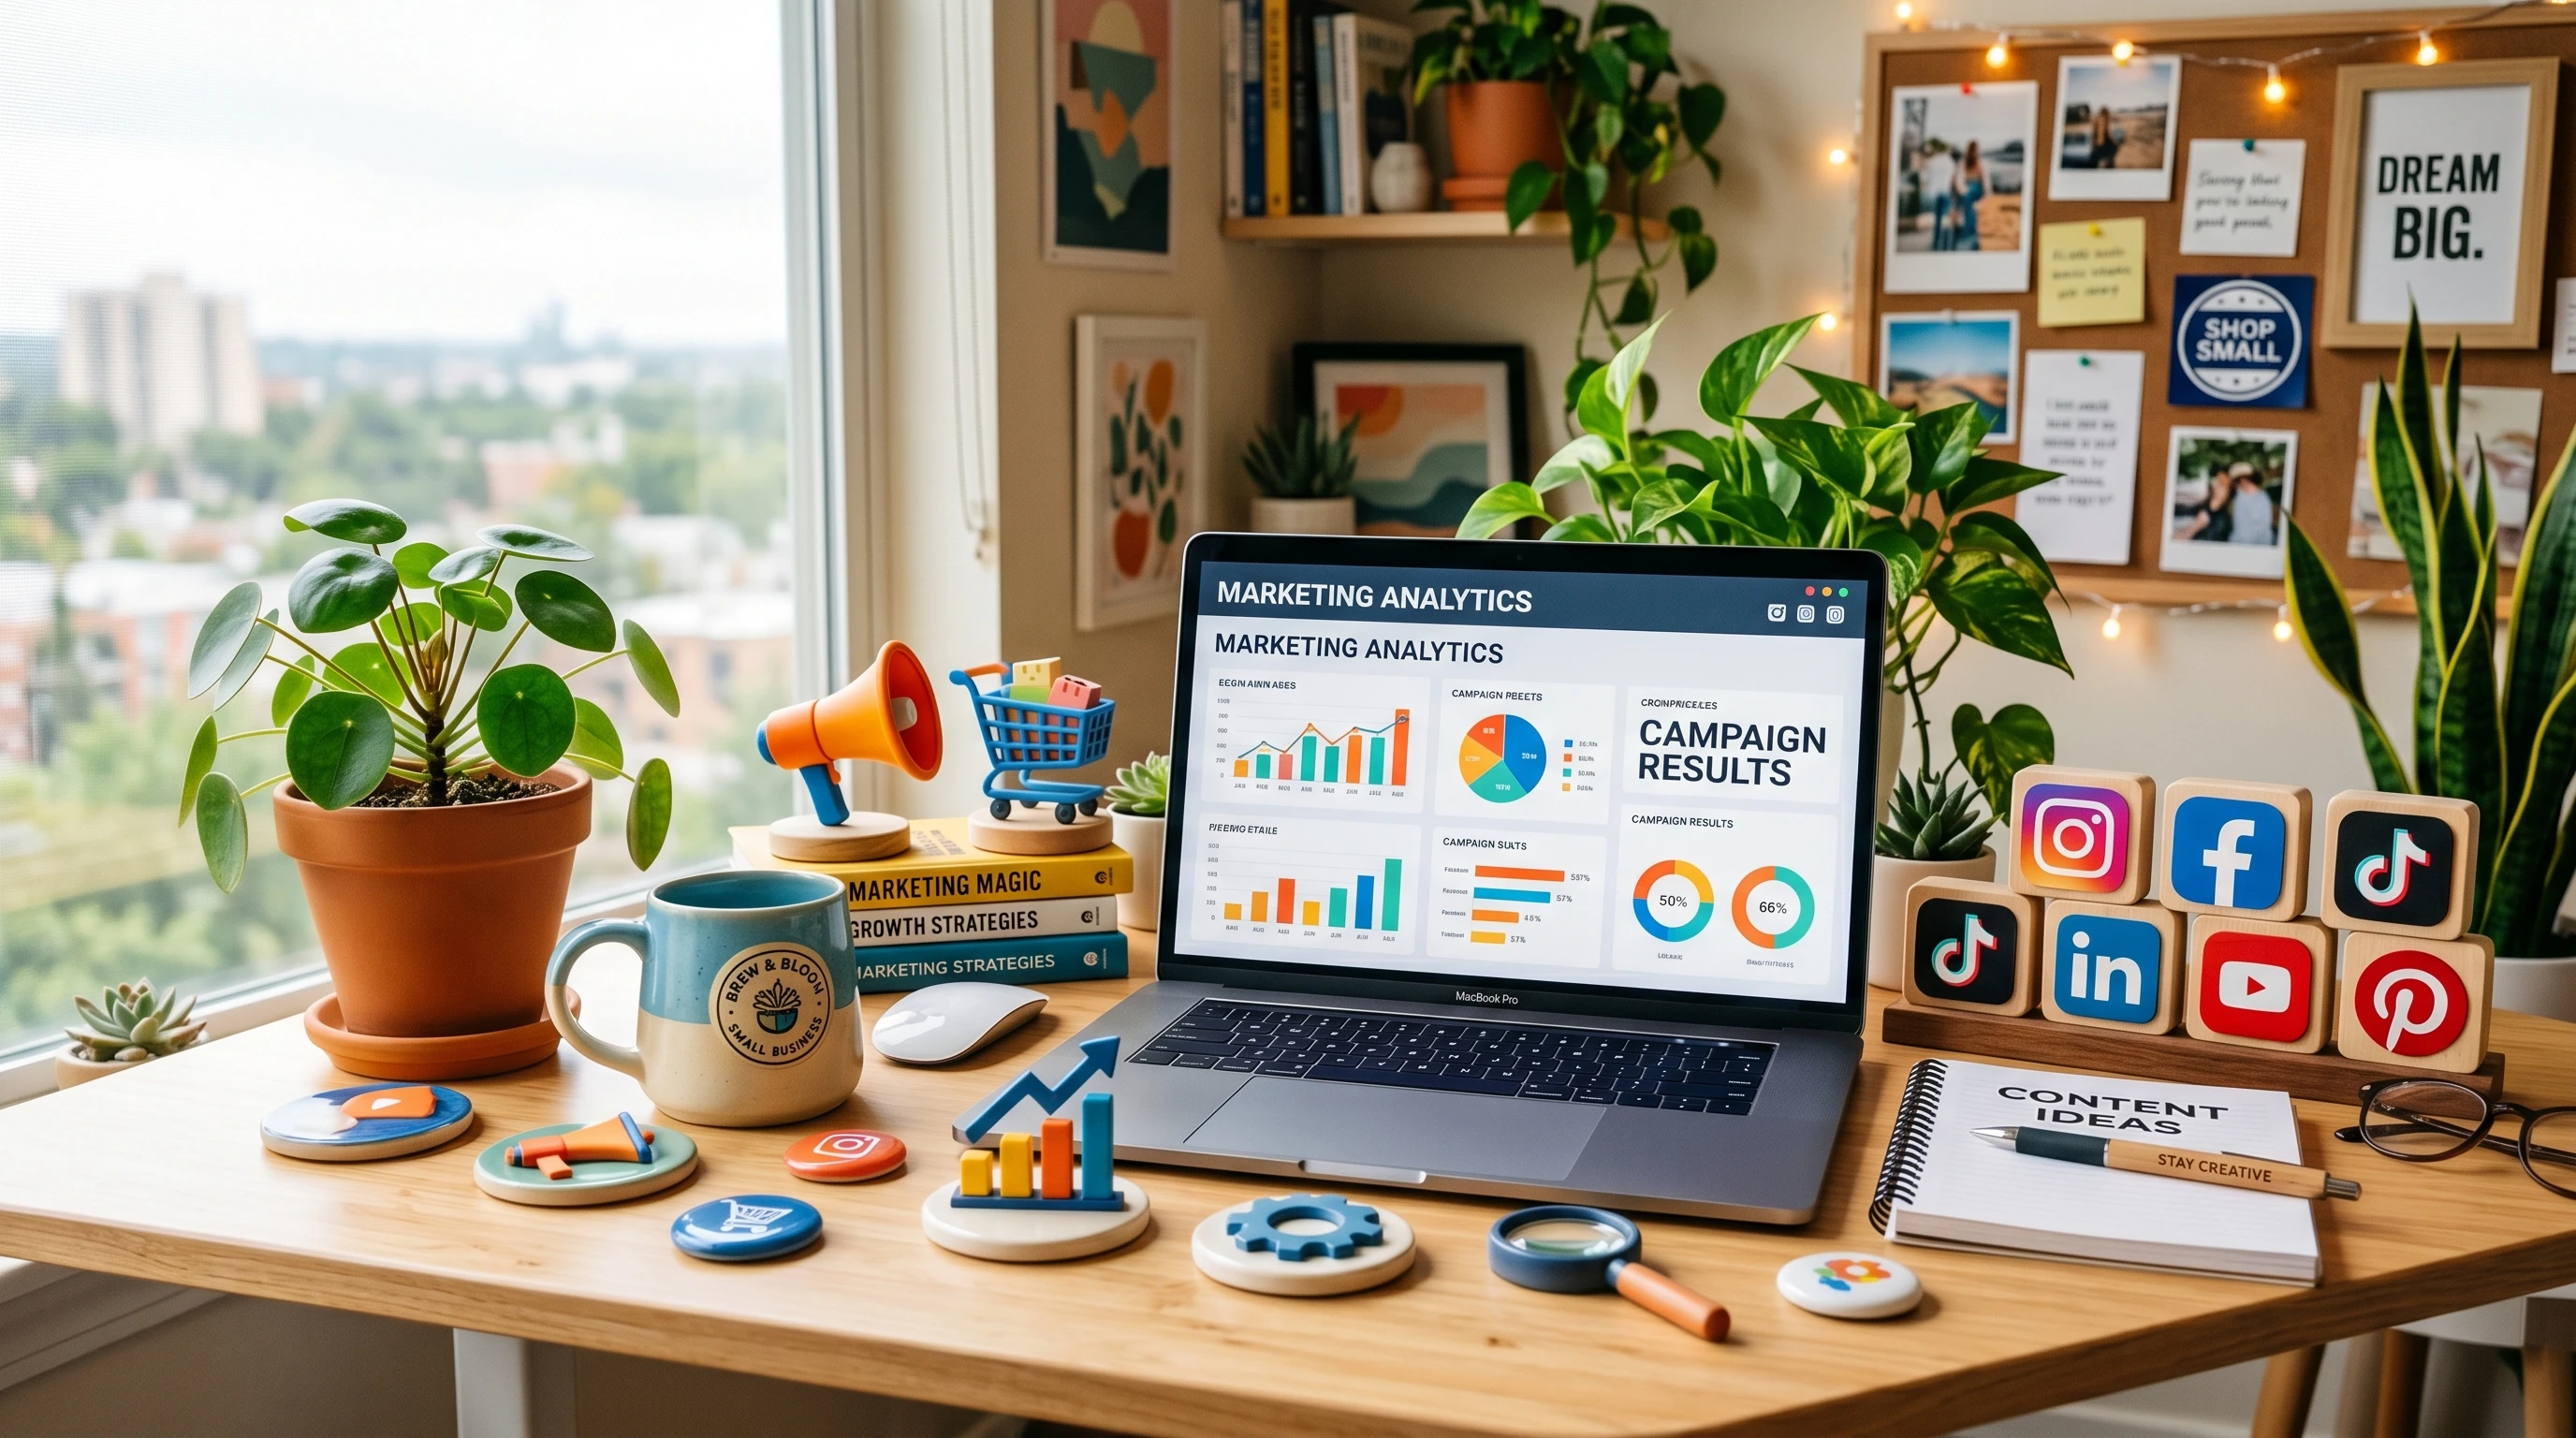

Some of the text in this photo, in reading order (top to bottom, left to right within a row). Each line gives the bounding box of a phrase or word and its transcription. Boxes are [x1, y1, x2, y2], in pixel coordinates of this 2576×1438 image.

[2378, 154, 2499, 193] DREAM
[2393, 205, 2483, 259] BIG.
[2204, 317, 2276, 340] SHOP
[2195, 339, 2282, 363] SMALL
[1217, 580, 1532, 613] MARKETING ANALYTICS
[1215, 633, 1503, 664] MARKETING ANALYTICS
[1452, 689, 1503, 699] CAMPAIGN
[1640, 719, 1826, 754] CAMPAIGN
[1638, 753, 1792, 786] RESULTS
[1632, 814, 1734, 829] CAMPAIGN RESULTS
[1442, 837, 1495, 848] CAMPAIGN
[2203, 818, 2255, 907] f
[849, 870, 1042, 902] MARKETING MAGIC
[1557, 894, 1573, 902] 57%
[1659, 895, 1688, 908] 50%
[1759, 902, 1787, 915] 66%
[851, 910, 1038, 939] GROWTH STRATEGIES
[953, 954, 1055, 974] STRATEGIES
[2071, 931, 2142, 1005] in
[725, 963, 759, 1003] BREW
[765, 959, 776, 972] &
[1456, 990, 1518, 1005] MacBook Pro
[728, 1017, 822, 1057] SMALL BUSINESS
[1998, 1086, 2229, 1120] CONTENT
[2037, 1108, 2182, 1135] IDEAS
[2158, 1153, 2272, 1183] STAY CREATIVE
